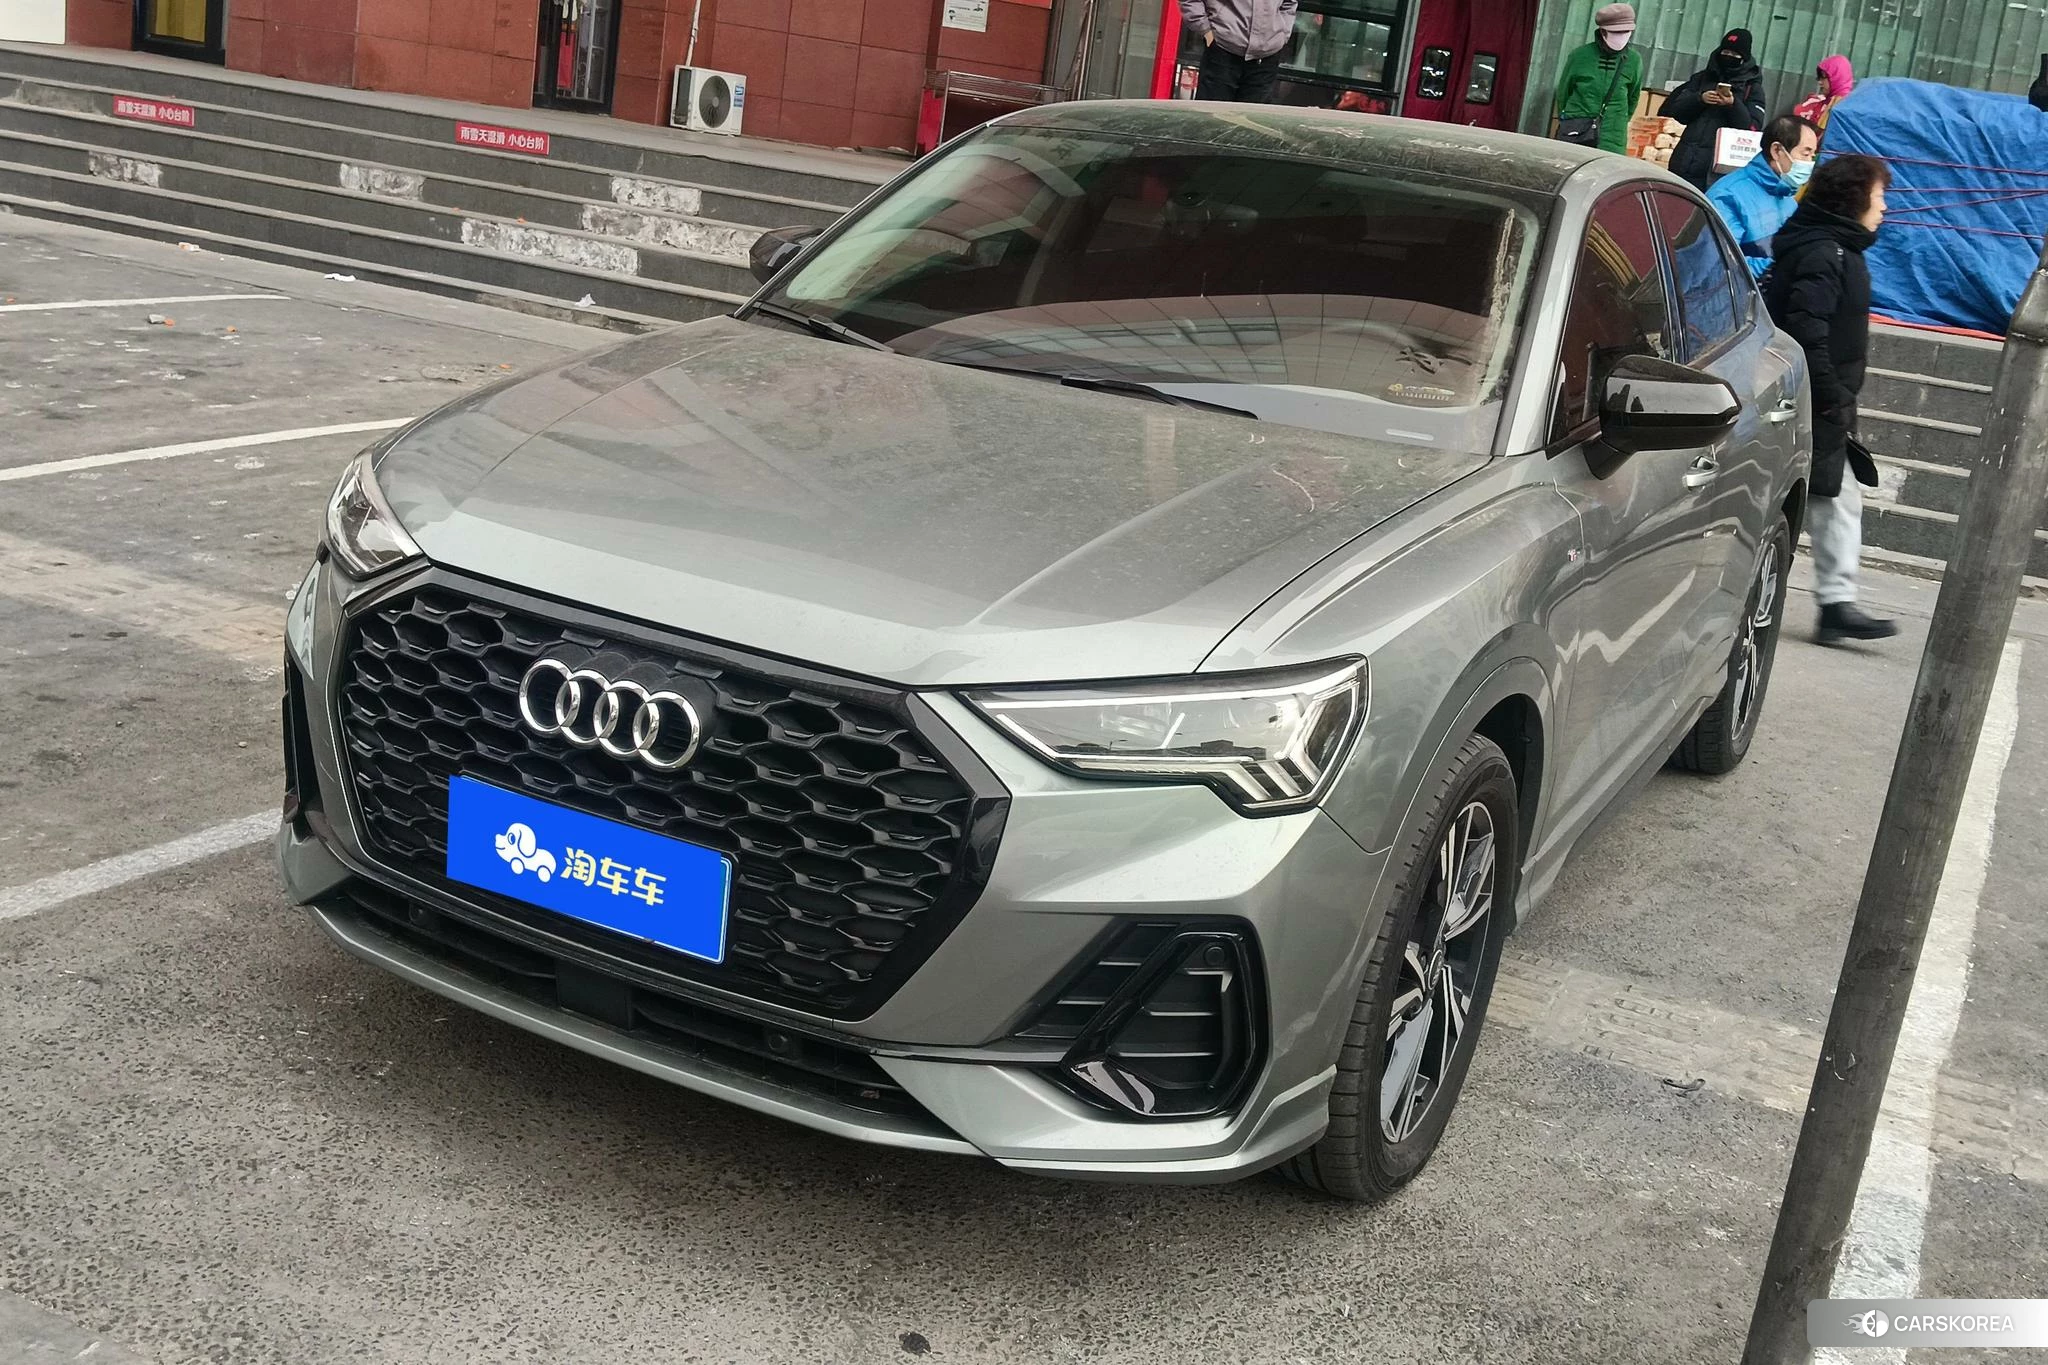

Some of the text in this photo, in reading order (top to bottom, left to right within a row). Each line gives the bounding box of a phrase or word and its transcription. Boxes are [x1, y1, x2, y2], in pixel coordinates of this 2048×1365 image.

[158, 106, 191, 123] 小心台阶
[460, 126, 545, 151] 雨雪天湿滑 小心台阶
